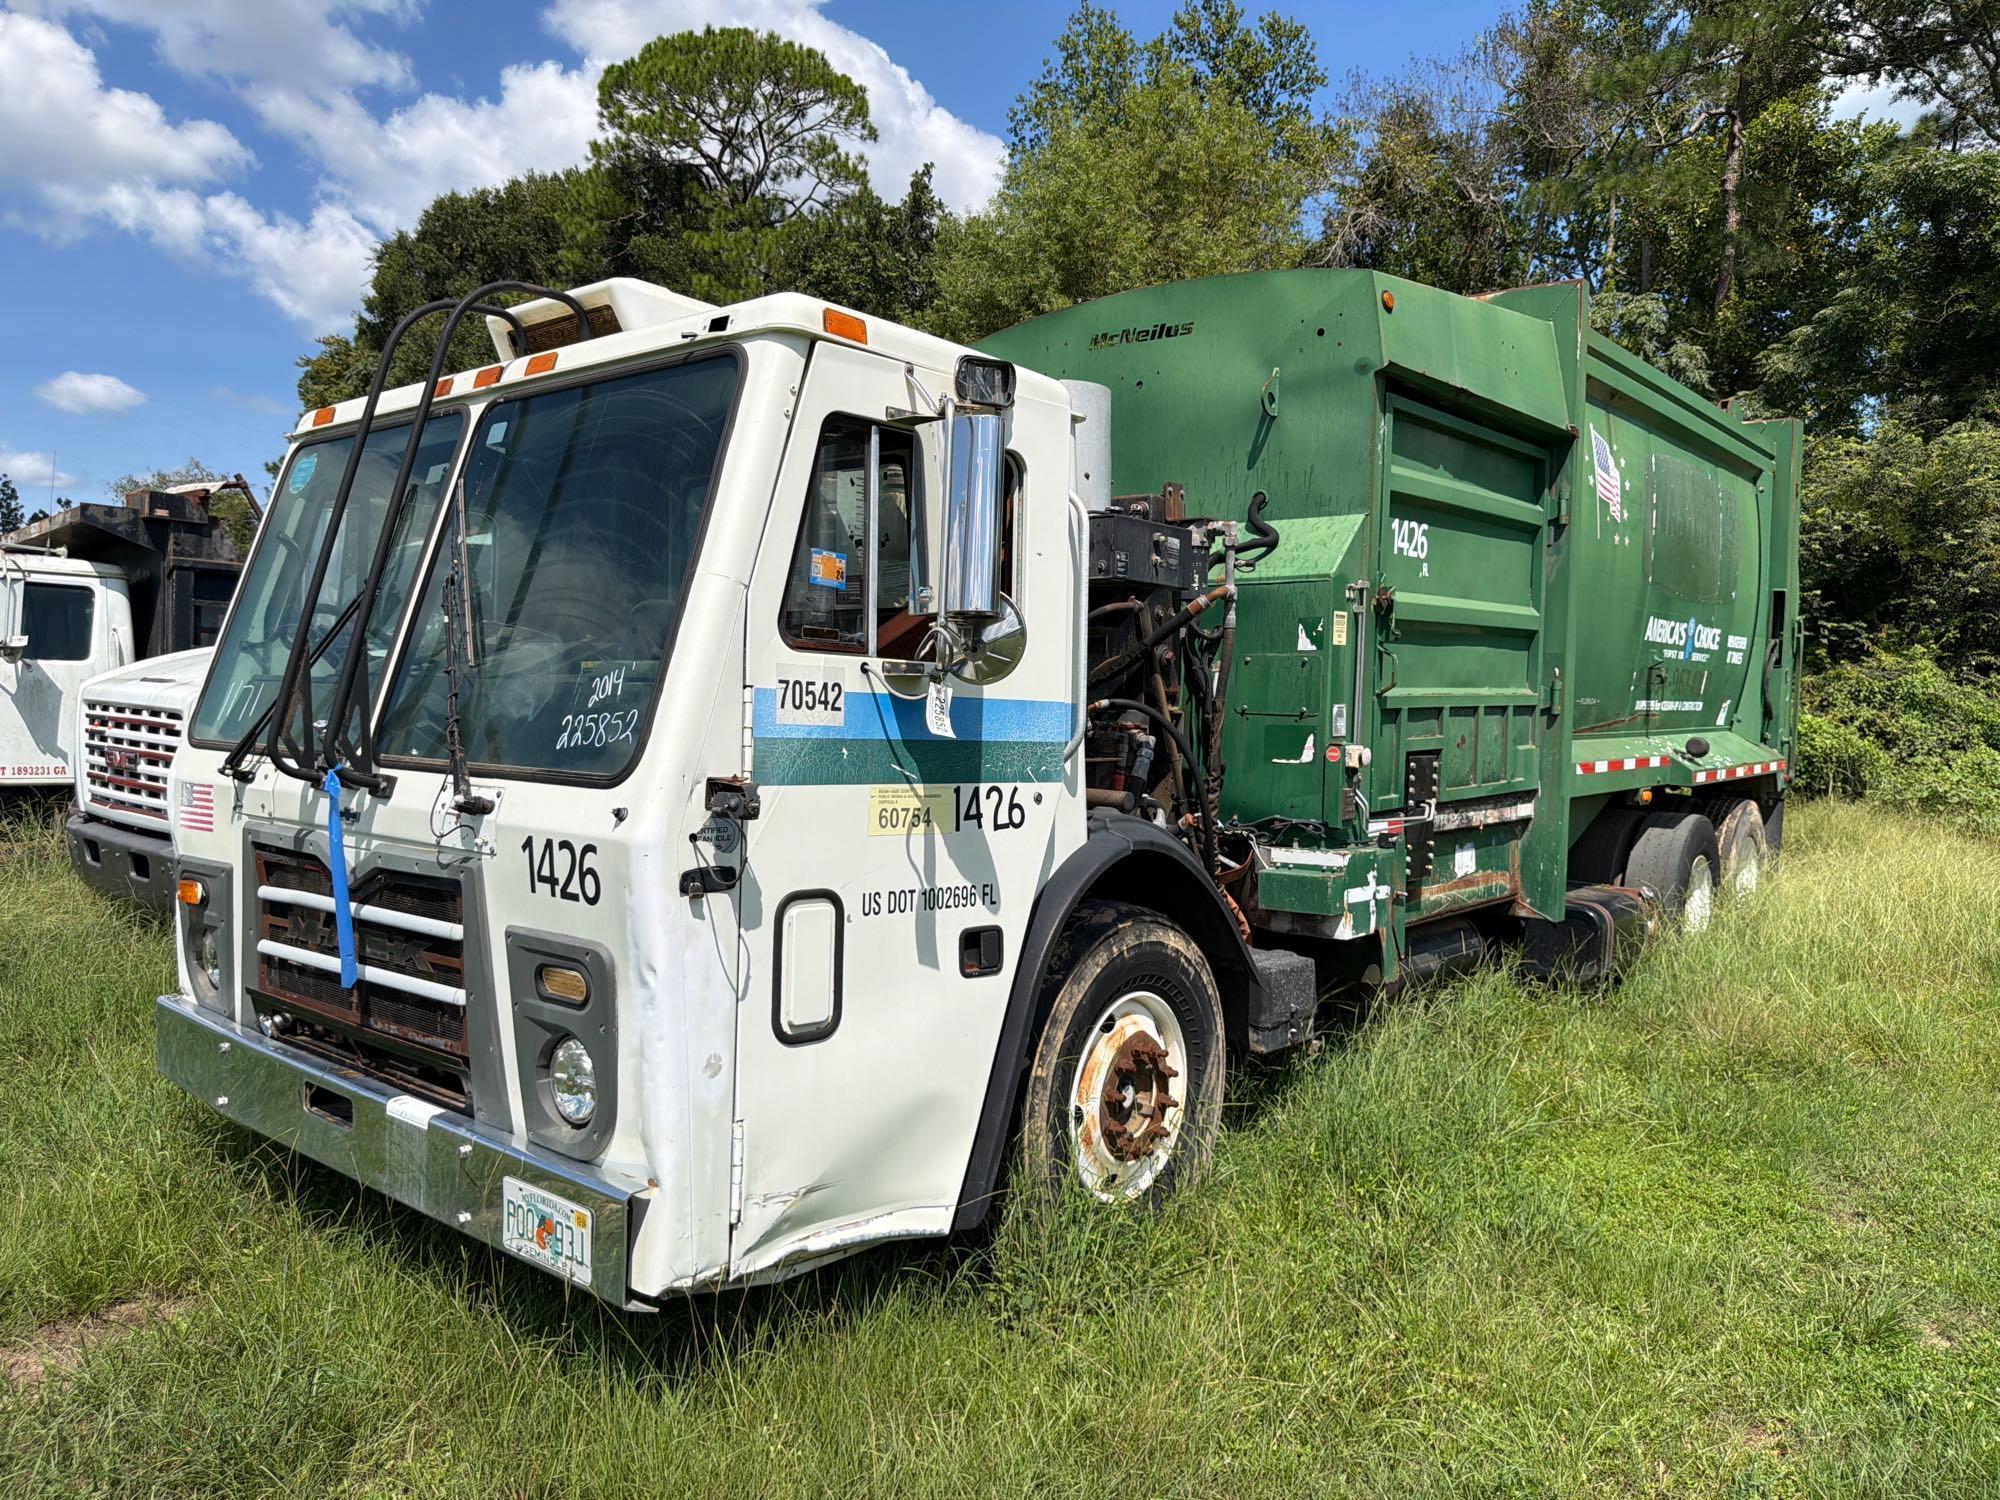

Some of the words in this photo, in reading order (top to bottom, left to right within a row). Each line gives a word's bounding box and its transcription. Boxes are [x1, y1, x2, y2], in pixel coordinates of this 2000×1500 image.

[1391, 518, 1429, 559] 1426
[1644, 616, 1688, 646] AMERICA'S
[1694, 623, 1721, 650] CHOICE
[588, 666, 626, 708] 2014
[778, 679, 842, 711] 70542
[556, 709, 638, 750] 225852
[11, 766, 51, 776] 1893231
[54, 766, 67, 776] GA
[878, 807, 932, 829] 60754
[953, 785, 1026, 832] 1426
[521, 834, 602, 906] 1426
[862, 891, 881, 916] US
[888, 889, 916, 914] DOT
[921, 884, 977, 911] 1002696
[982, 883, 997, 906] FL
[524, 1243, 568, 1272] SEMINOLE
